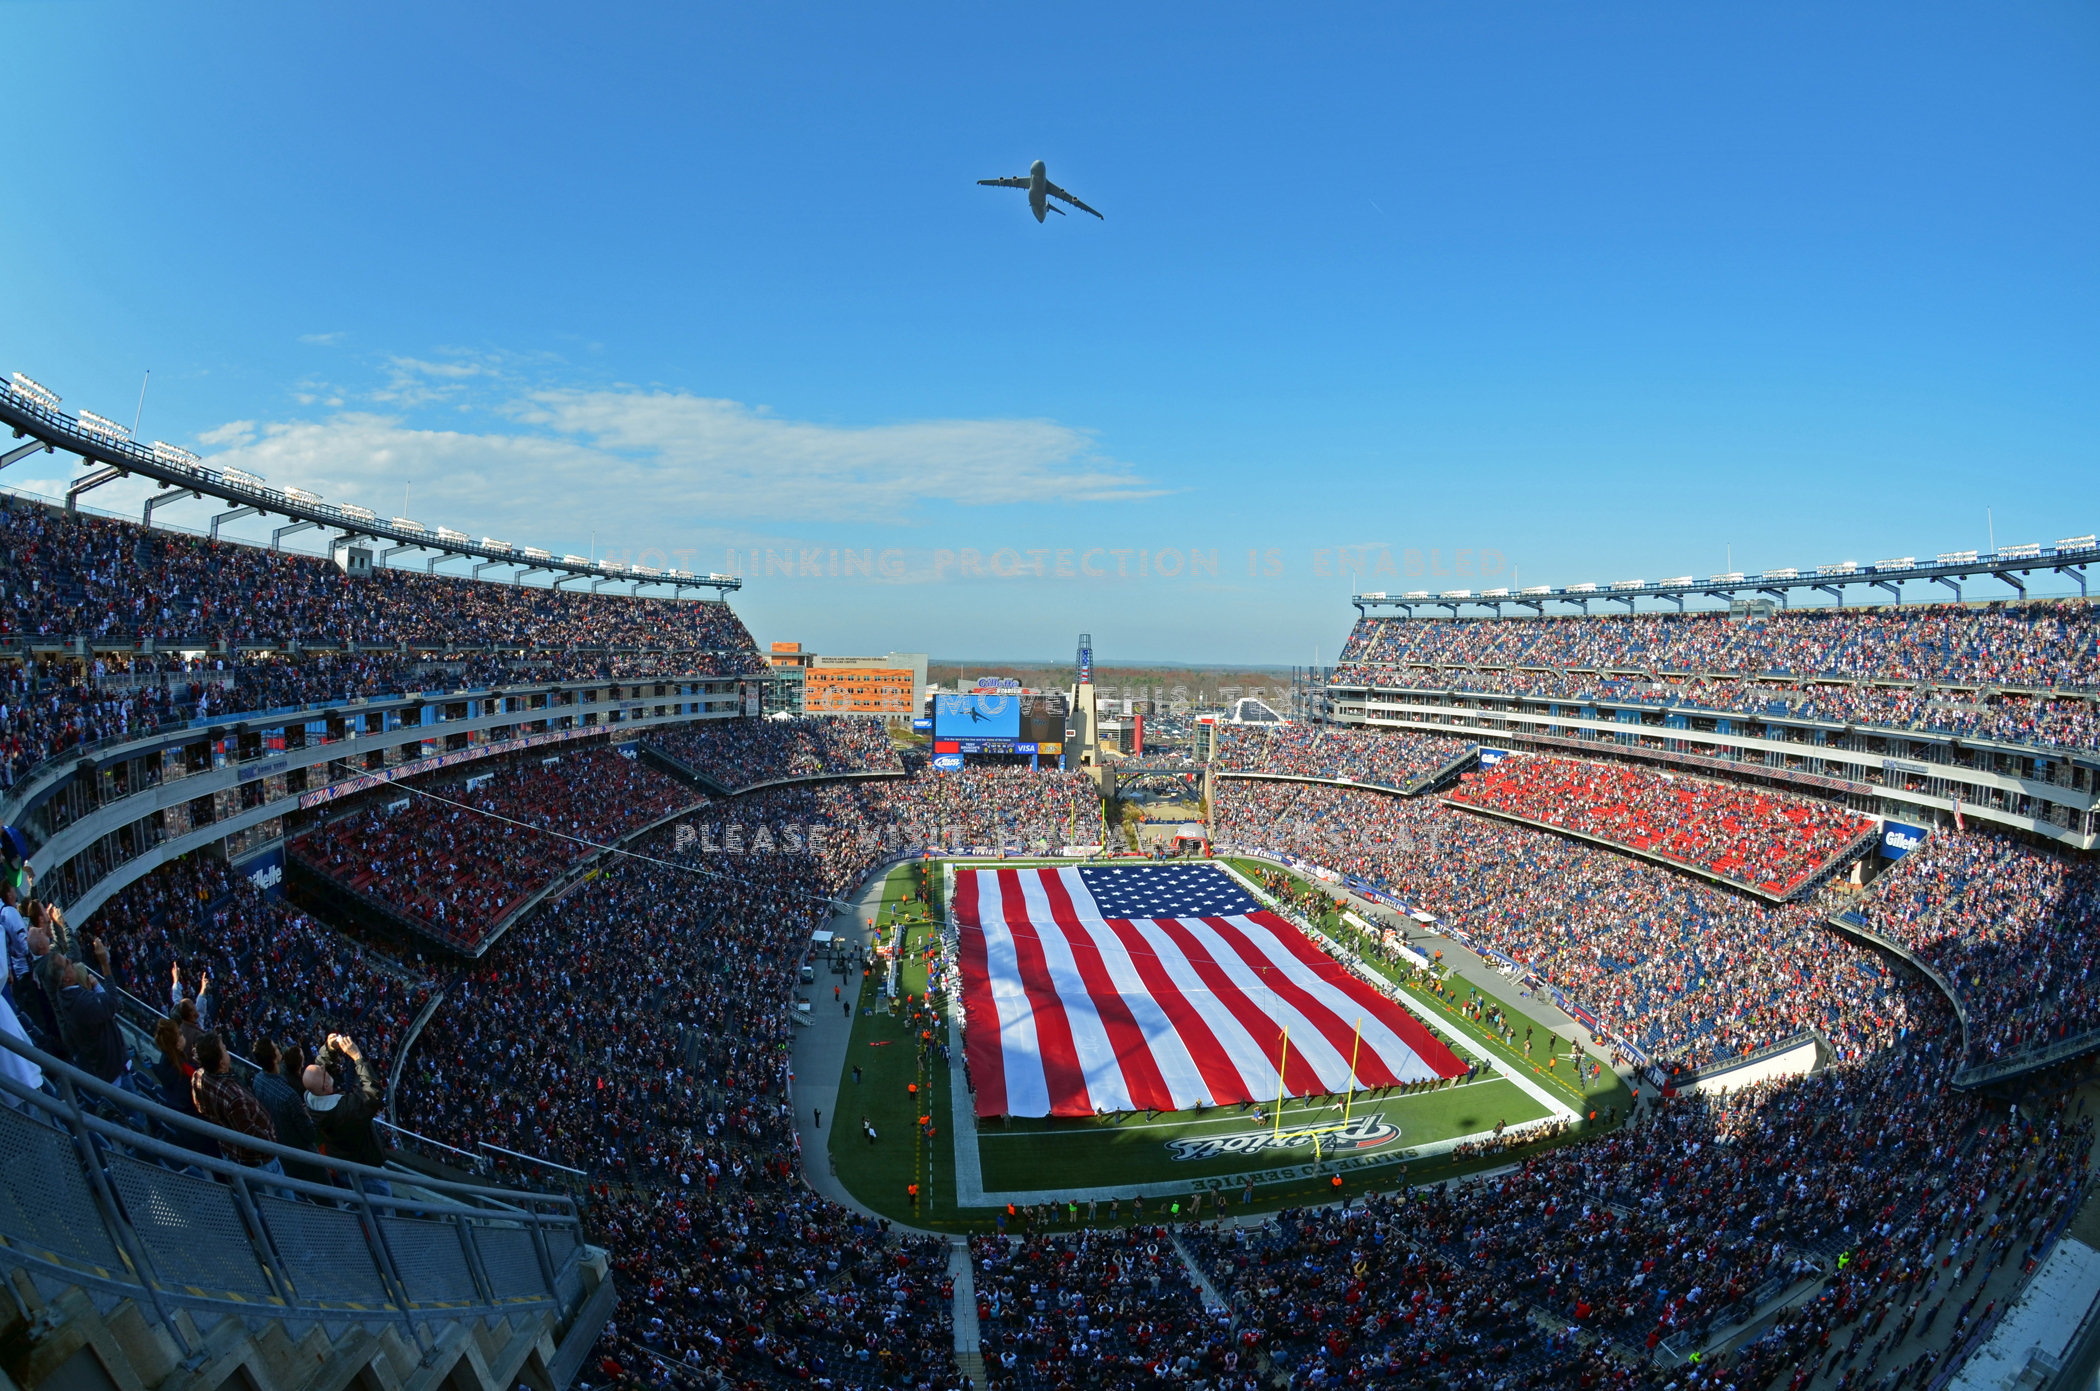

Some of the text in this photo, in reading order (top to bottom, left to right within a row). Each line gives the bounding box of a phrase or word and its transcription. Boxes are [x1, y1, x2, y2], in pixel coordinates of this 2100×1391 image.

[978, 678, 1019, 688] Gillette
[1017, 744, 1036, 752] VISA
[248, 864, 282, 890] illette
[1164, 1112, 1402, 1161] Patriots
[1191, 1148, 1419, 1191] SALUTE TO SERVICE
